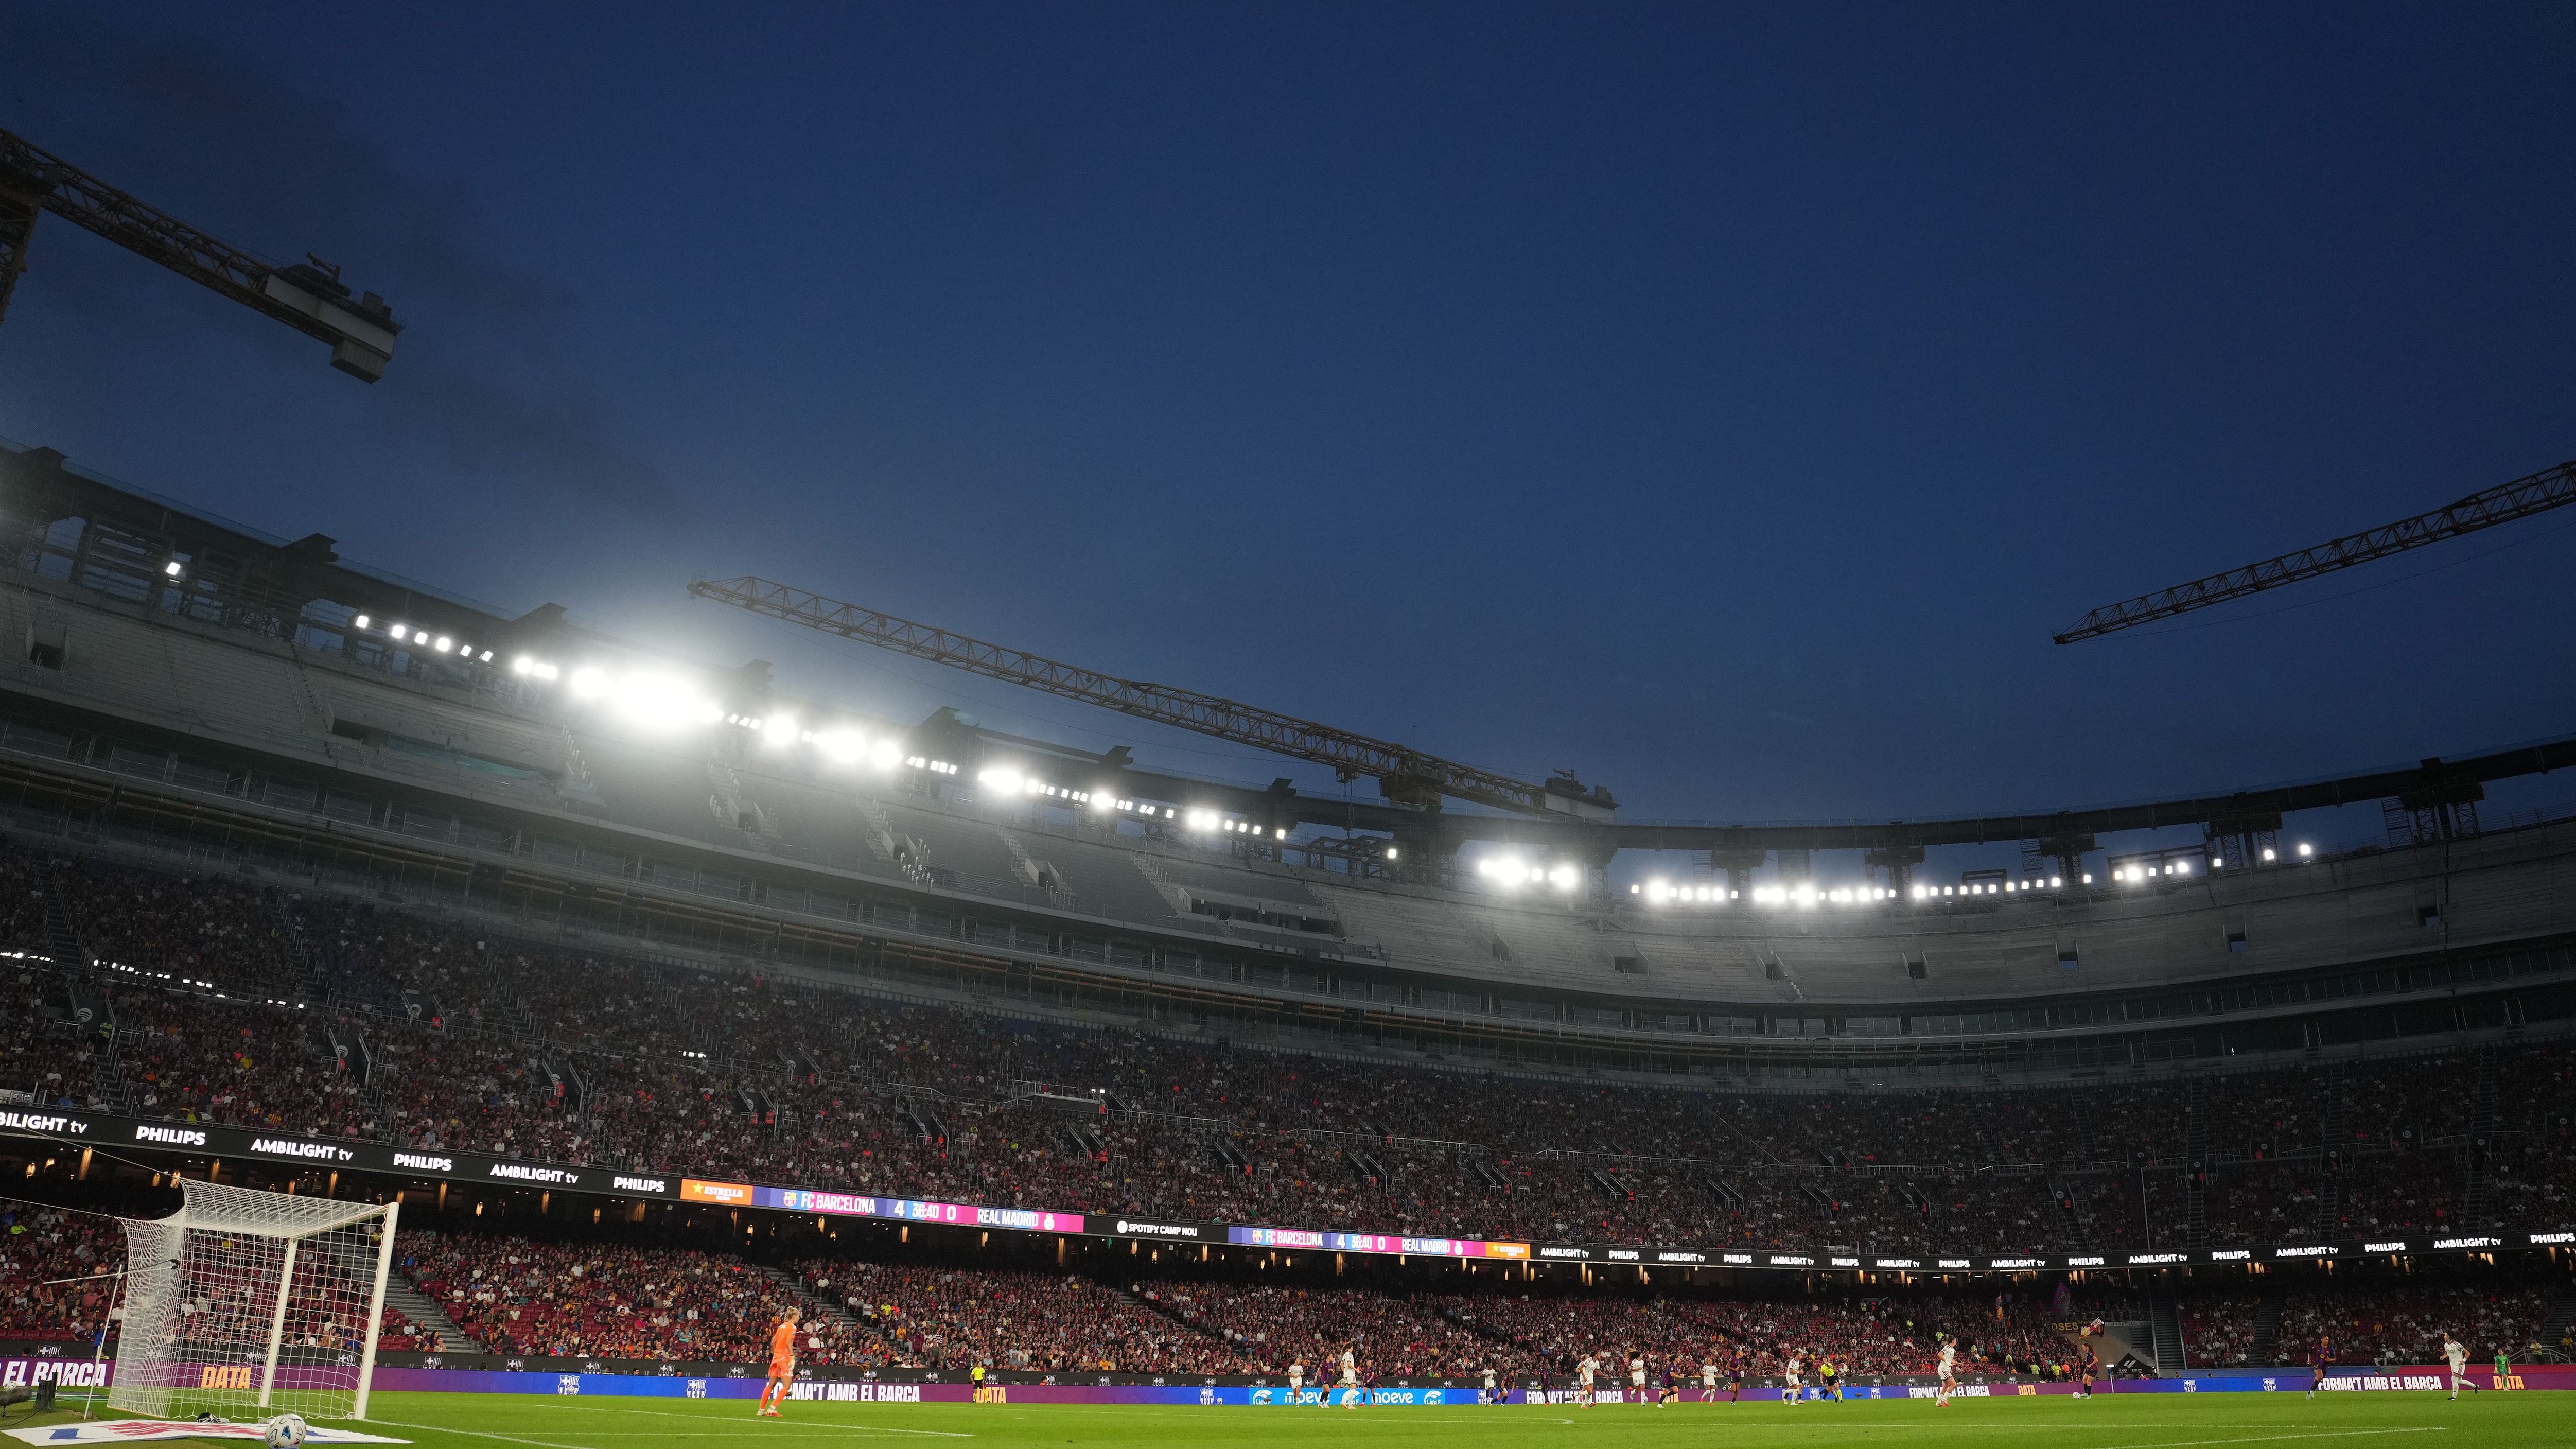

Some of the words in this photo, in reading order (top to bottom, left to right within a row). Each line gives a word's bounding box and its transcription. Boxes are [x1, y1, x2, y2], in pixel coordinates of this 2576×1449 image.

[71, 1121, 87, 1133] tv
[136, 1126, 205, 1145] PHILIPS
[251, 1139, 336, 1159] AMBILIGHT
[339, 1149, 353, 1160] tv
[394, 1154, 451, 1171] PHILIPS
[490, 1164, 564, 1182] AMBILIGHT
[566, 1173, 578, 1183] tv
[614, 1177, 664, 1192] PHILIPS
[801, 1192, 814, 1210] FC
[816, 1195, 875, 1213] BARCELONA
[894, 1201, 904, 1216] 4
[913, 1202, 939, 1219] 36:40
[947, 1206, 956, 1220] 0
[978, 1209, 1000, 1224] REAL
[1002, 1211, 1038, 1227] MADRID
[1128, 1224, 1159, 1233] SPOTIFY
[1160, 1226, 1181, 1235] CAMP
[1182, 1227, 1197, 1236] NOU
[1266, 1230, 1275, 1245] FC
[1277, 1231, 1323, 1246] BARCELONA
[1337, 1235, 1345, 1248] 4
[1352, 1236, 1372, 1249] 36:40
[1378, 1237, 1385, 1250] 0
[1403, 1239, 1420, 1251] REAL
[1422, 1240, 1450, 1253] MADRID
[2434, 1238, 2489, 1248] AMBILIGHT
[2530, 1233, 2575, 1243] PHILIPS
[1541, 1248, 1581, 1257] AMBILIGHT
[2276, 1247, 2327, 1256] AMBILIGHT
[2365, 1243, 2405, 1252] PHILIPS
[1609, 1251, 1639, 1260] PHILIPS
[1659, 1253, 1697, 1261] AMBILIGHT
[1724, 1255, 1752, 1263] PHILIPS
[1771, 1256, 1807, 1265] AMBILIGHT
[2129, 1254, 2177, 1263] AMBILIGHT
[2213, 1251, 2250, 1260] PHILIPS
[3, 1361, 27, 1386] EL
[201, 1367, 251, 1388] DATA
[2364, 1377, 2389, 1390] AMB
[2390, 1377, 2403, 1390] EL
[827, 1384, 857, 1401] AMB
[861, 1385, 874, 1401] EL
[1957, 1386, 1966, 1397] EL
[2018, 1385, 2036, 1395] DATA
[1371, 1392, 1413, 1404] moeve
